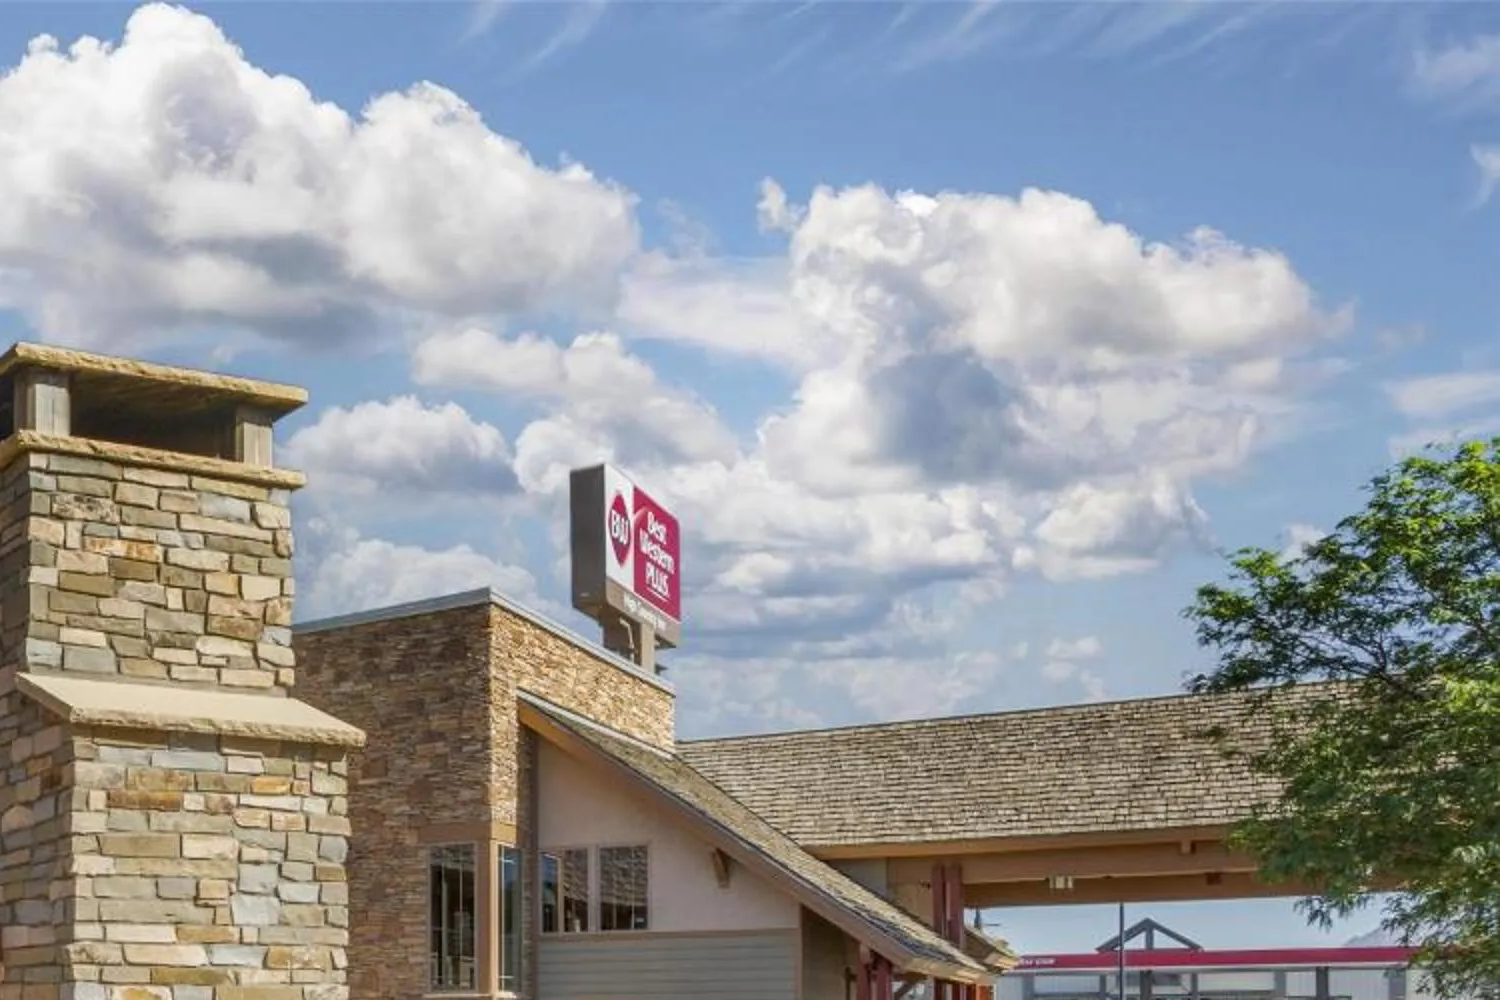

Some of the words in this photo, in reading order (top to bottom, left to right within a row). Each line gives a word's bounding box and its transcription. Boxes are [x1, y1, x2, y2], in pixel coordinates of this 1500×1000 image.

[647, 511, 667, 545] Best
[639, 527, 675, 575] Western
[645, 561, 669, 598] PLUS
